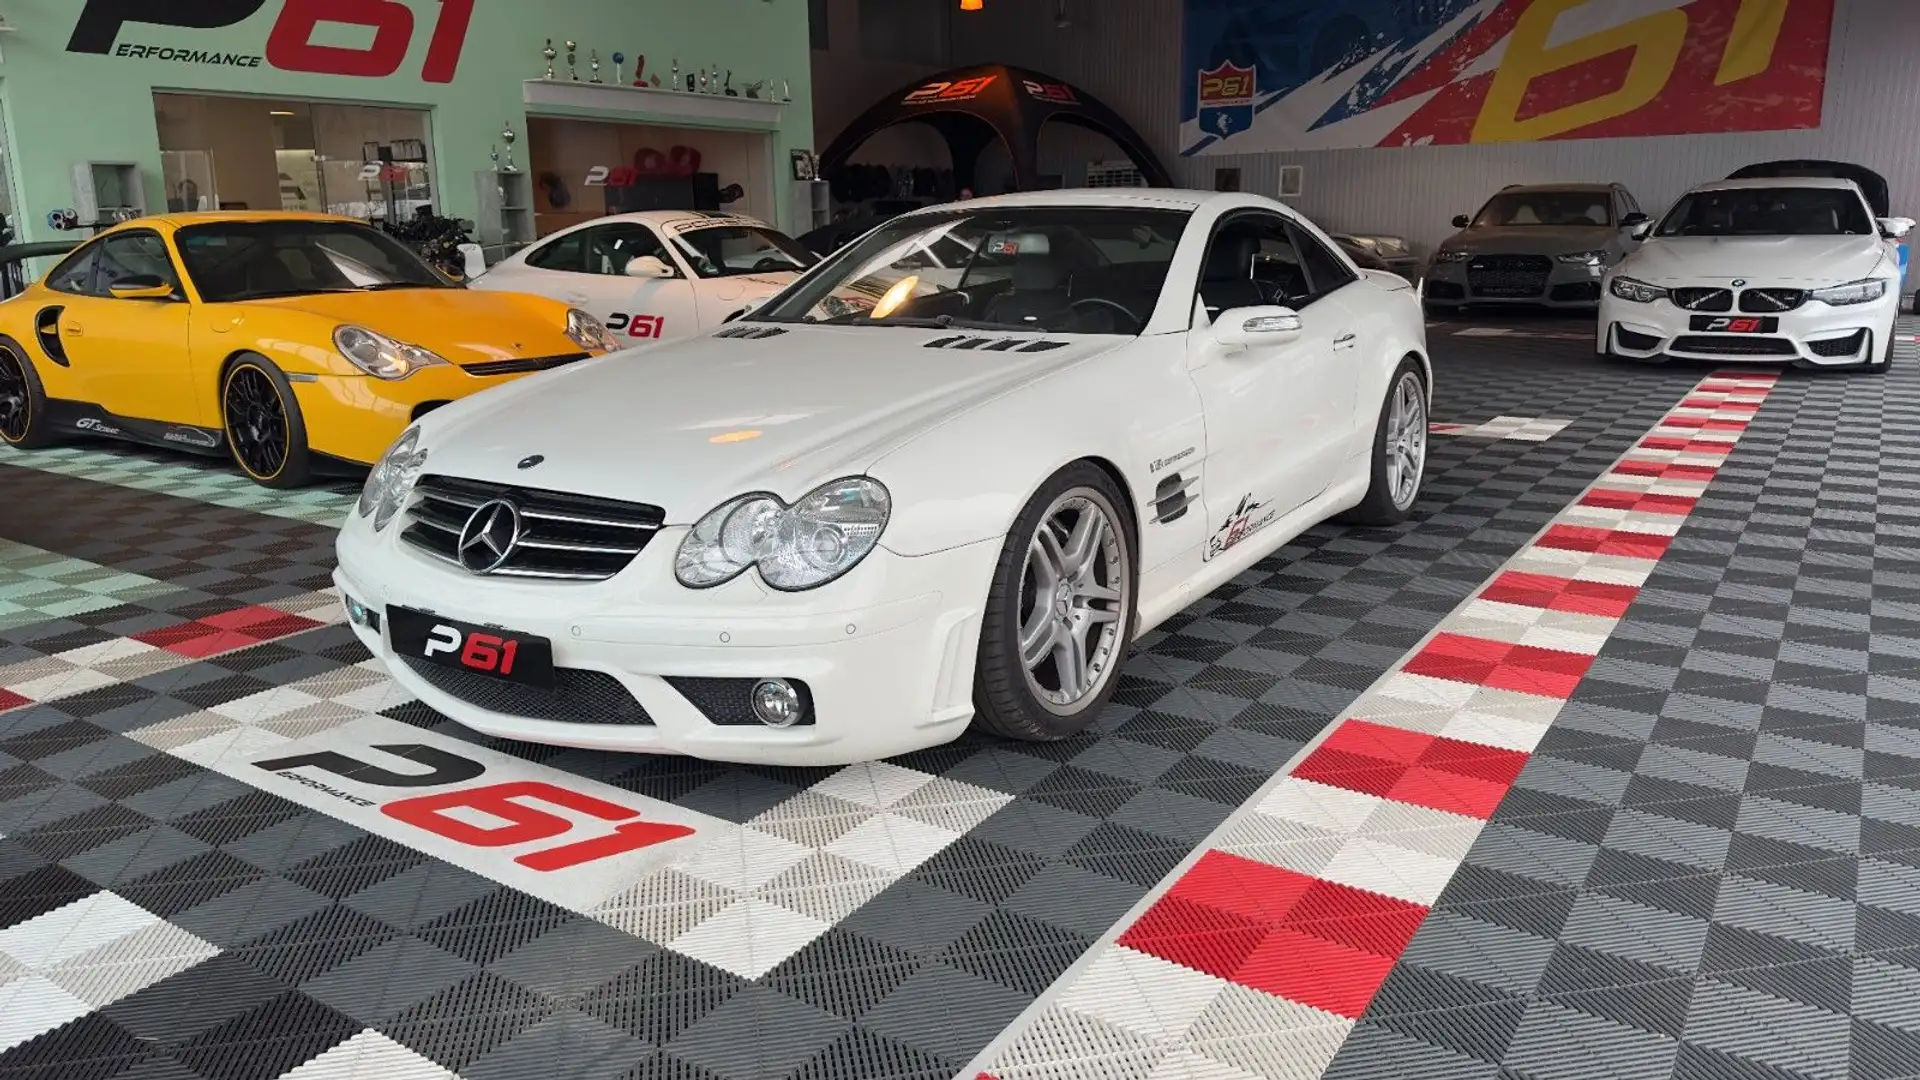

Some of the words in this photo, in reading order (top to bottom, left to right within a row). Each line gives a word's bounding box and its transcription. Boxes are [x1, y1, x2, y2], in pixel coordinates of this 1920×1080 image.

[903, 75, 998, 100] P61
[1202, 75, 1250, 97] P61
[605, 312, 664, 339] P61
[1706, 317, 1762, 333] P61
[424, 624, 520, 675] P61
[251, 744, 697, 872] P61
